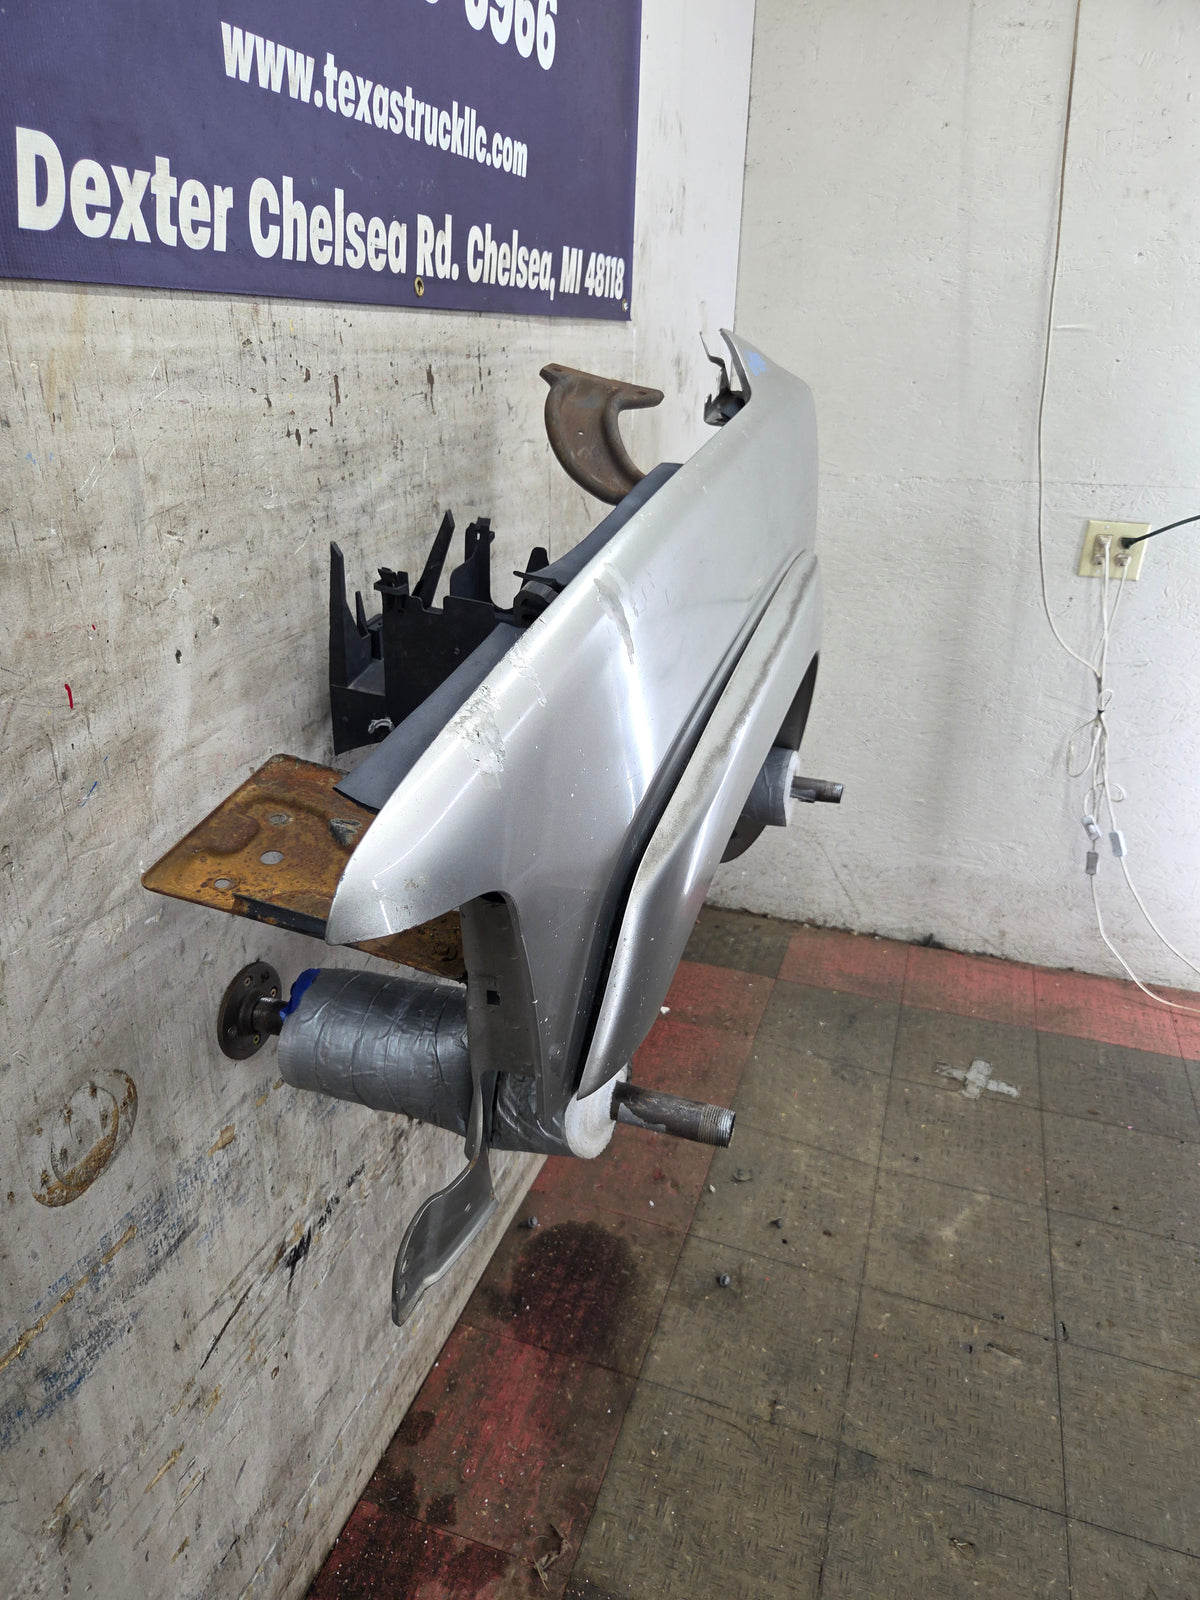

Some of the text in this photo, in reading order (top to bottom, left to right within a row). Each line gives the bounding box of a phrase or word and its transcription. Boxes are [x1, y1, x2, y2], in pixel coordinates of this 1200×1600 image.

[221, 21, 528, 178] www.texastruckllc.com
[465, 0, 558, 71] 66
[15, 126, 625, 301] Dexter Chelsea Rd. Chelsea, MI 48118
